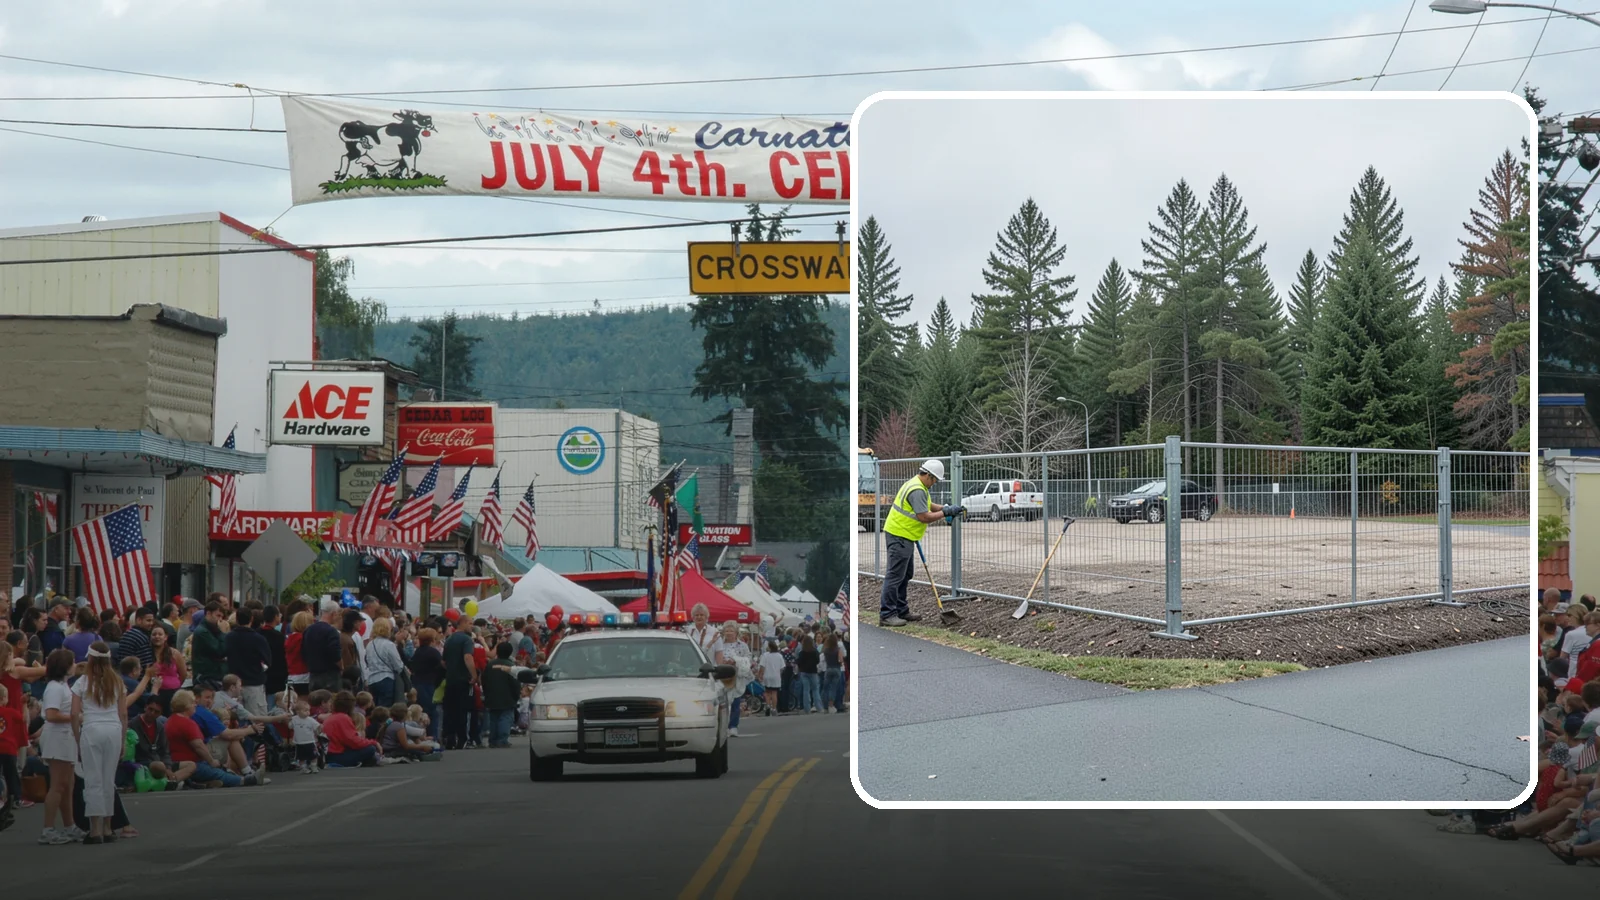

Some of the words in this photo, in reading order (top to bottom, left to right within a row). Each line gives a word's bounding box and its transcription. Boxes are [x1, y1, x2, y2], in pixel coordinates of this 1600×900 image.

[481, 141, 605, 192] JULY
[632, 150, 746, 198] 4th.
[697, 254, 850, 280] CROSSWA
[282, 380, 373, 420] ACE
[406, 409, 452, 421] CEDAR
[461, 409, 485, 421] LOG
[283, 421, 371, 436] Hardware
[416, 428, 477, 447] Coca-Cola
[83, 485, 94, 494] St.
[95, 485, 124, 495] Vincent
[126, 486, 136, 495] de
[137, 486, 155, 495] Paul
[688, 526, 742, 535] CRNATION
[699, 535, 730, 543] GLASS
